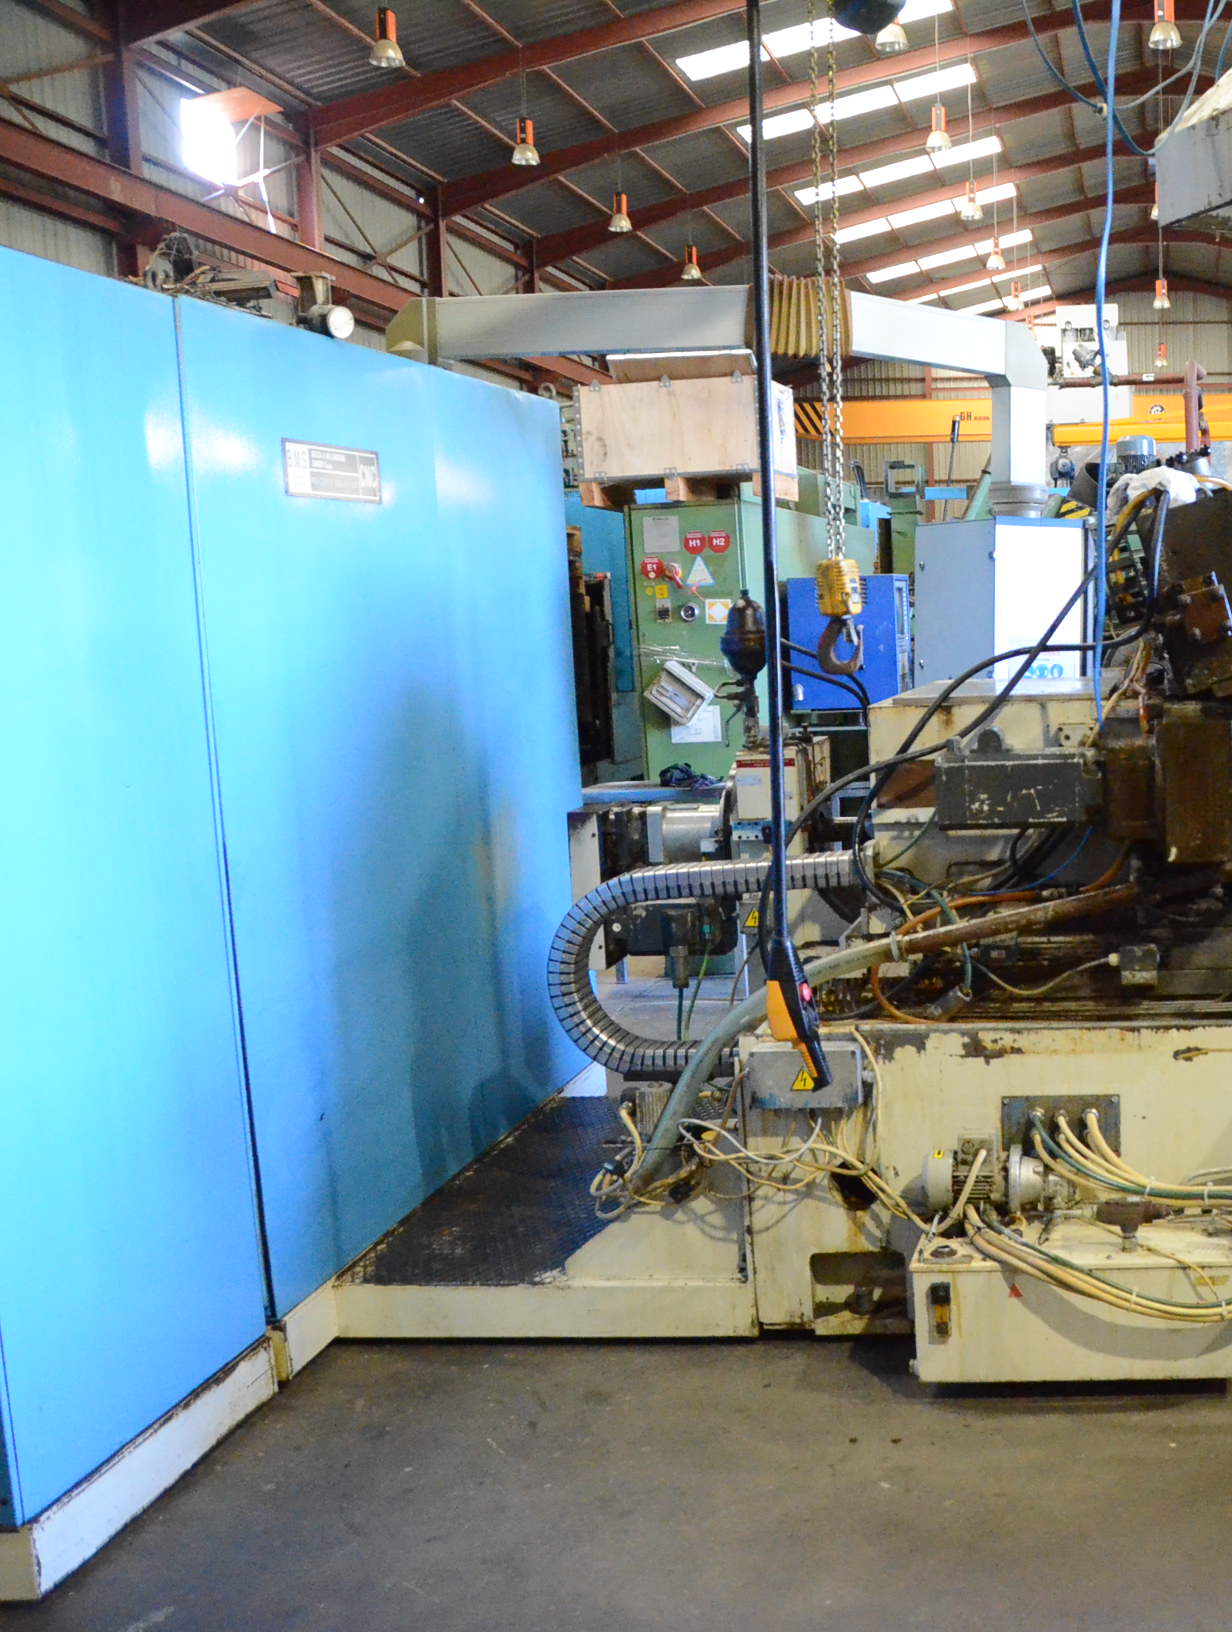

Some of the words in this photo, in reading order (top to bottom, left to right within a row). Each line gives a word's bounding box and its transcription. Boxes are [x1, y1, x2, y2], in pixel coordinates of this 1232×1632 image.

[688, 538, 701, 548] H1
[712, 537, 726, 546] H2
[646, 563, 658, 571] E1
